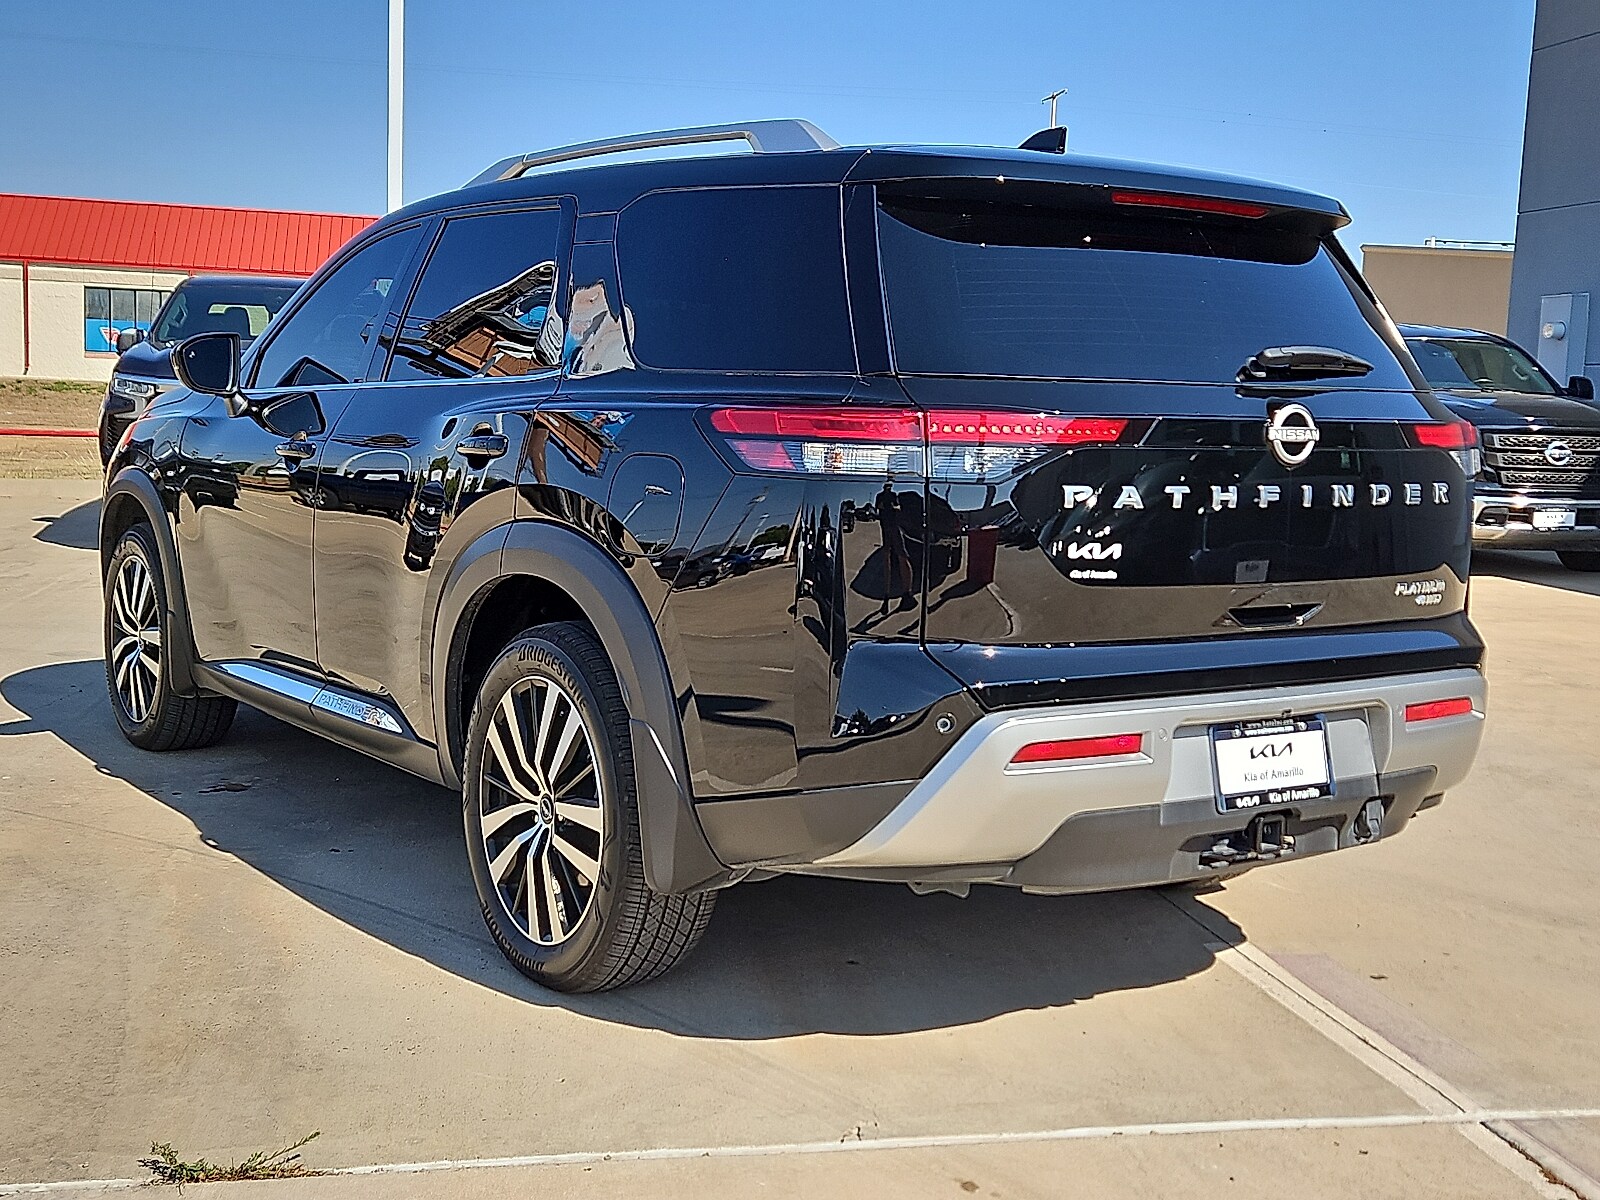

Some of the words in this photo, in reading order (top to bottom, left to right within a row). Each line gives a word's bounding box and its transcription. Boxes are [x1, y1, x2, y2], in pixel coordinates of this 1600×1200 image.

[1268, 428, 1320, 441] NISSAN
[1061, 482, 1450, 509] PATHFINDER
[1067, 541, 1122, 560] KIA
[517, 643, 587, 712] BRIDGESTONE
[1249, 742, 1293, 760] KIA
[1244, 772, 1258, 782] Kia
[1259, 770, 1269, 781] of
[1270, 766, 1304, 778] Amarillo
